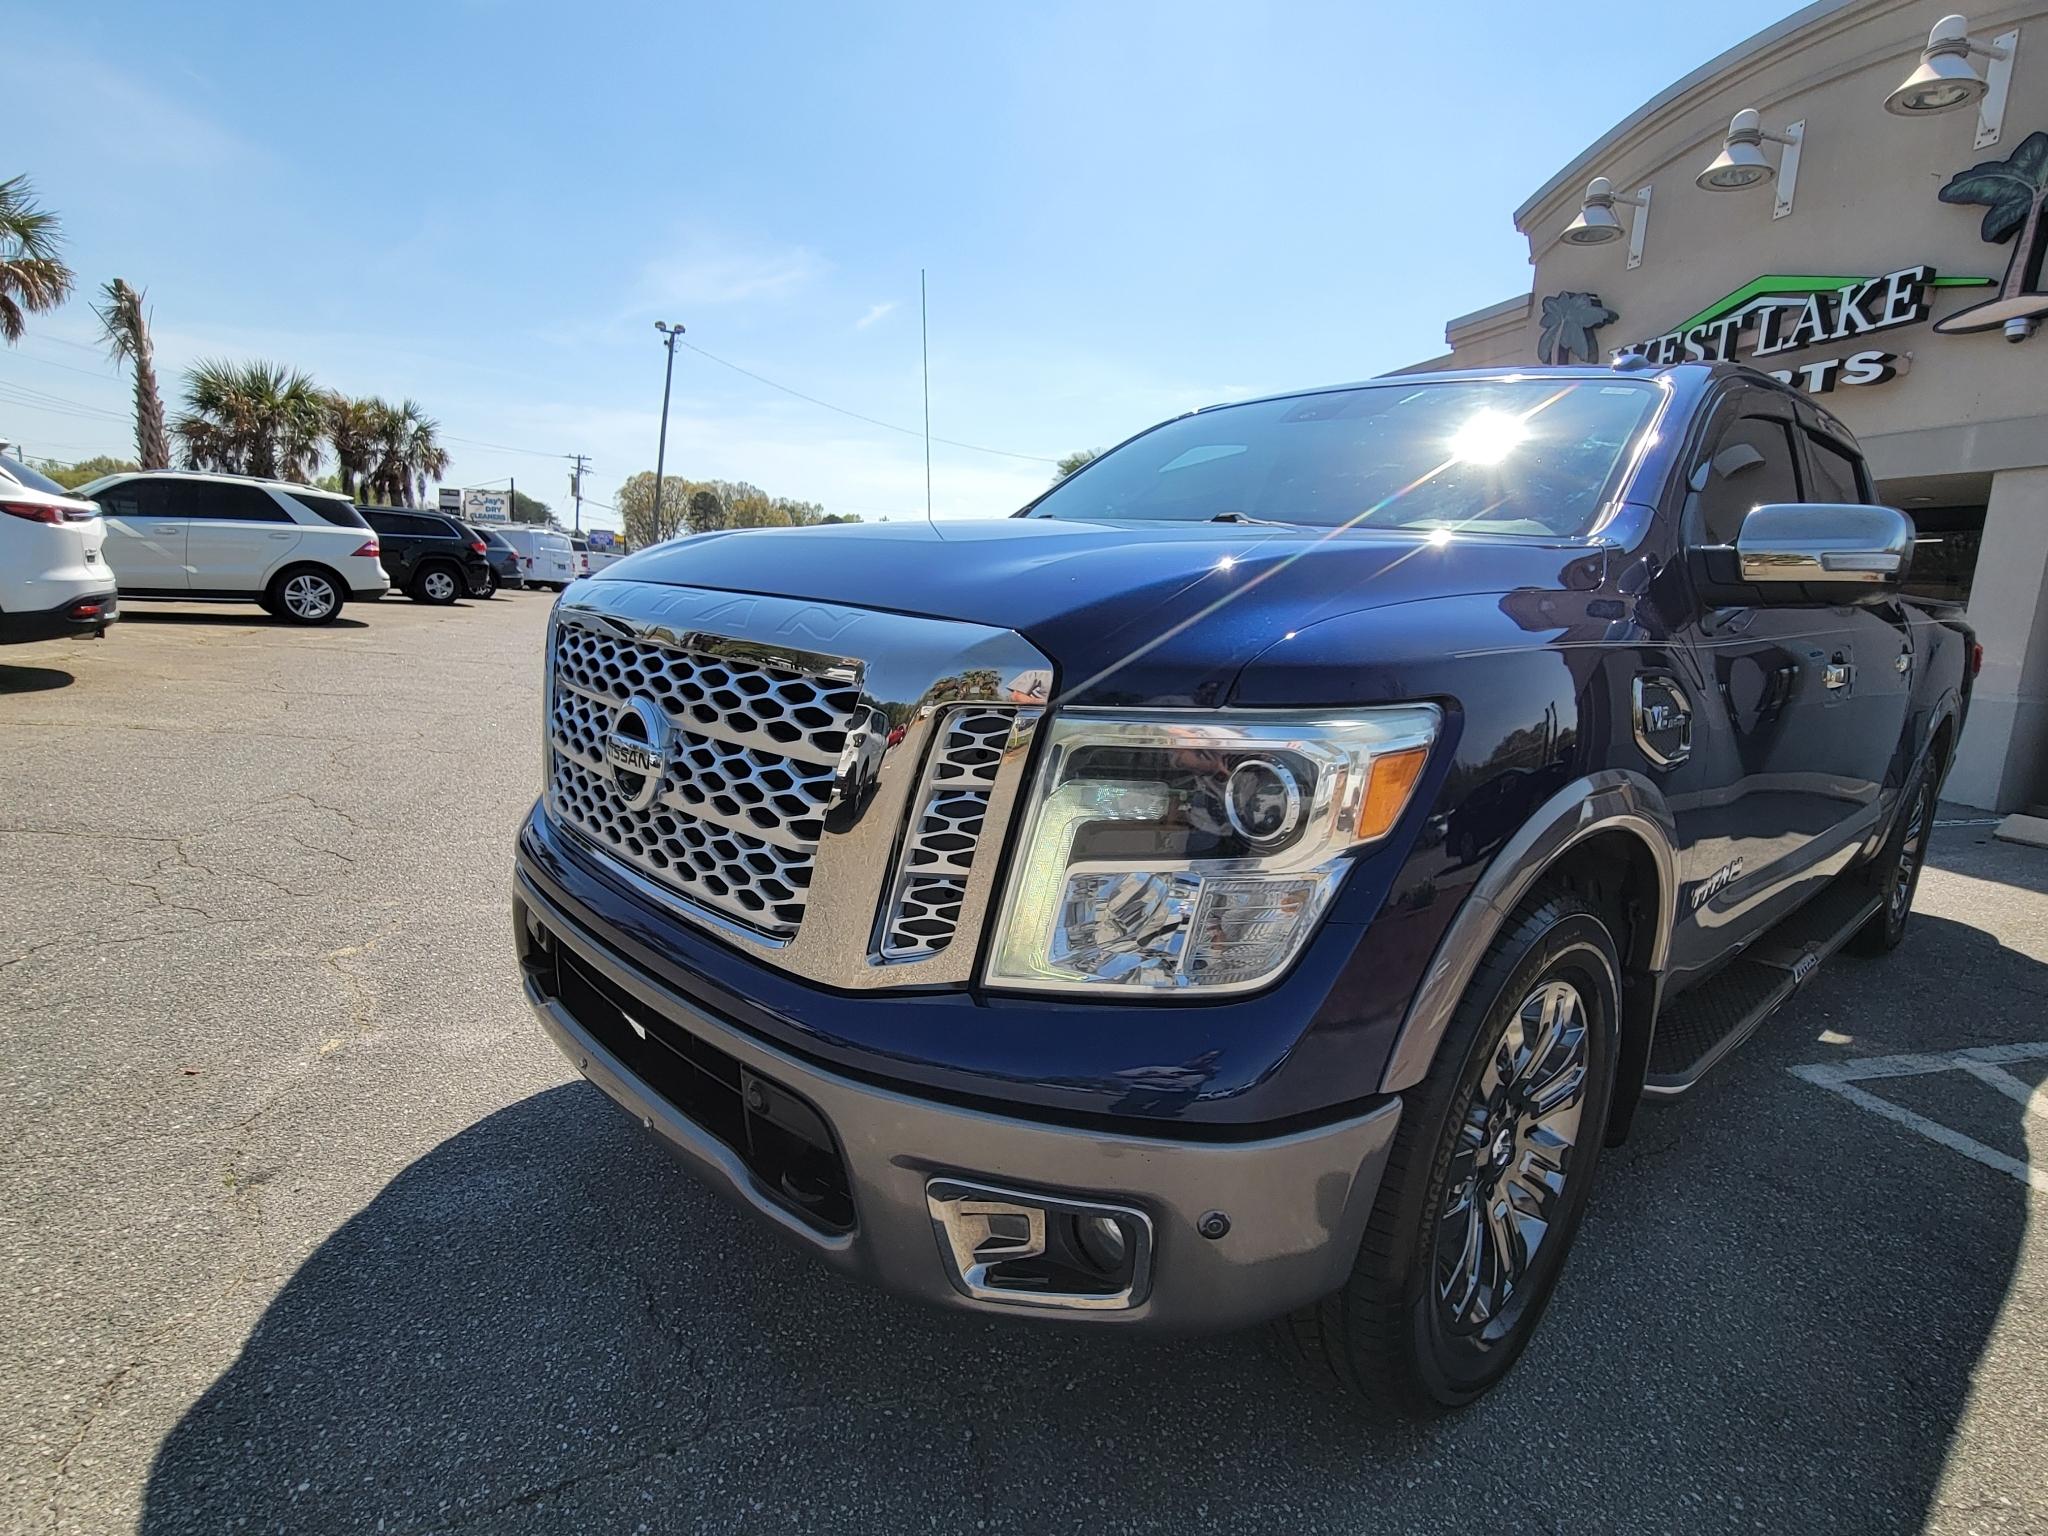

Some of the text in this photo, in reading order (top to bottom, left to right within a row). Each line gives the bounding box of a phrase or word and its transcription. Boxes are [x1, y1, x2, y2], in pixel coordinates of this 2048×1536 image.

[1751, 265, 1930, 357] LAKE
[469, 512, 506, 521] CLEANERS
[483, 496, 505, 506] Jay's
[579, 583, 866, 642] TITAN
[606, 739, 650, 770] NISSAN
